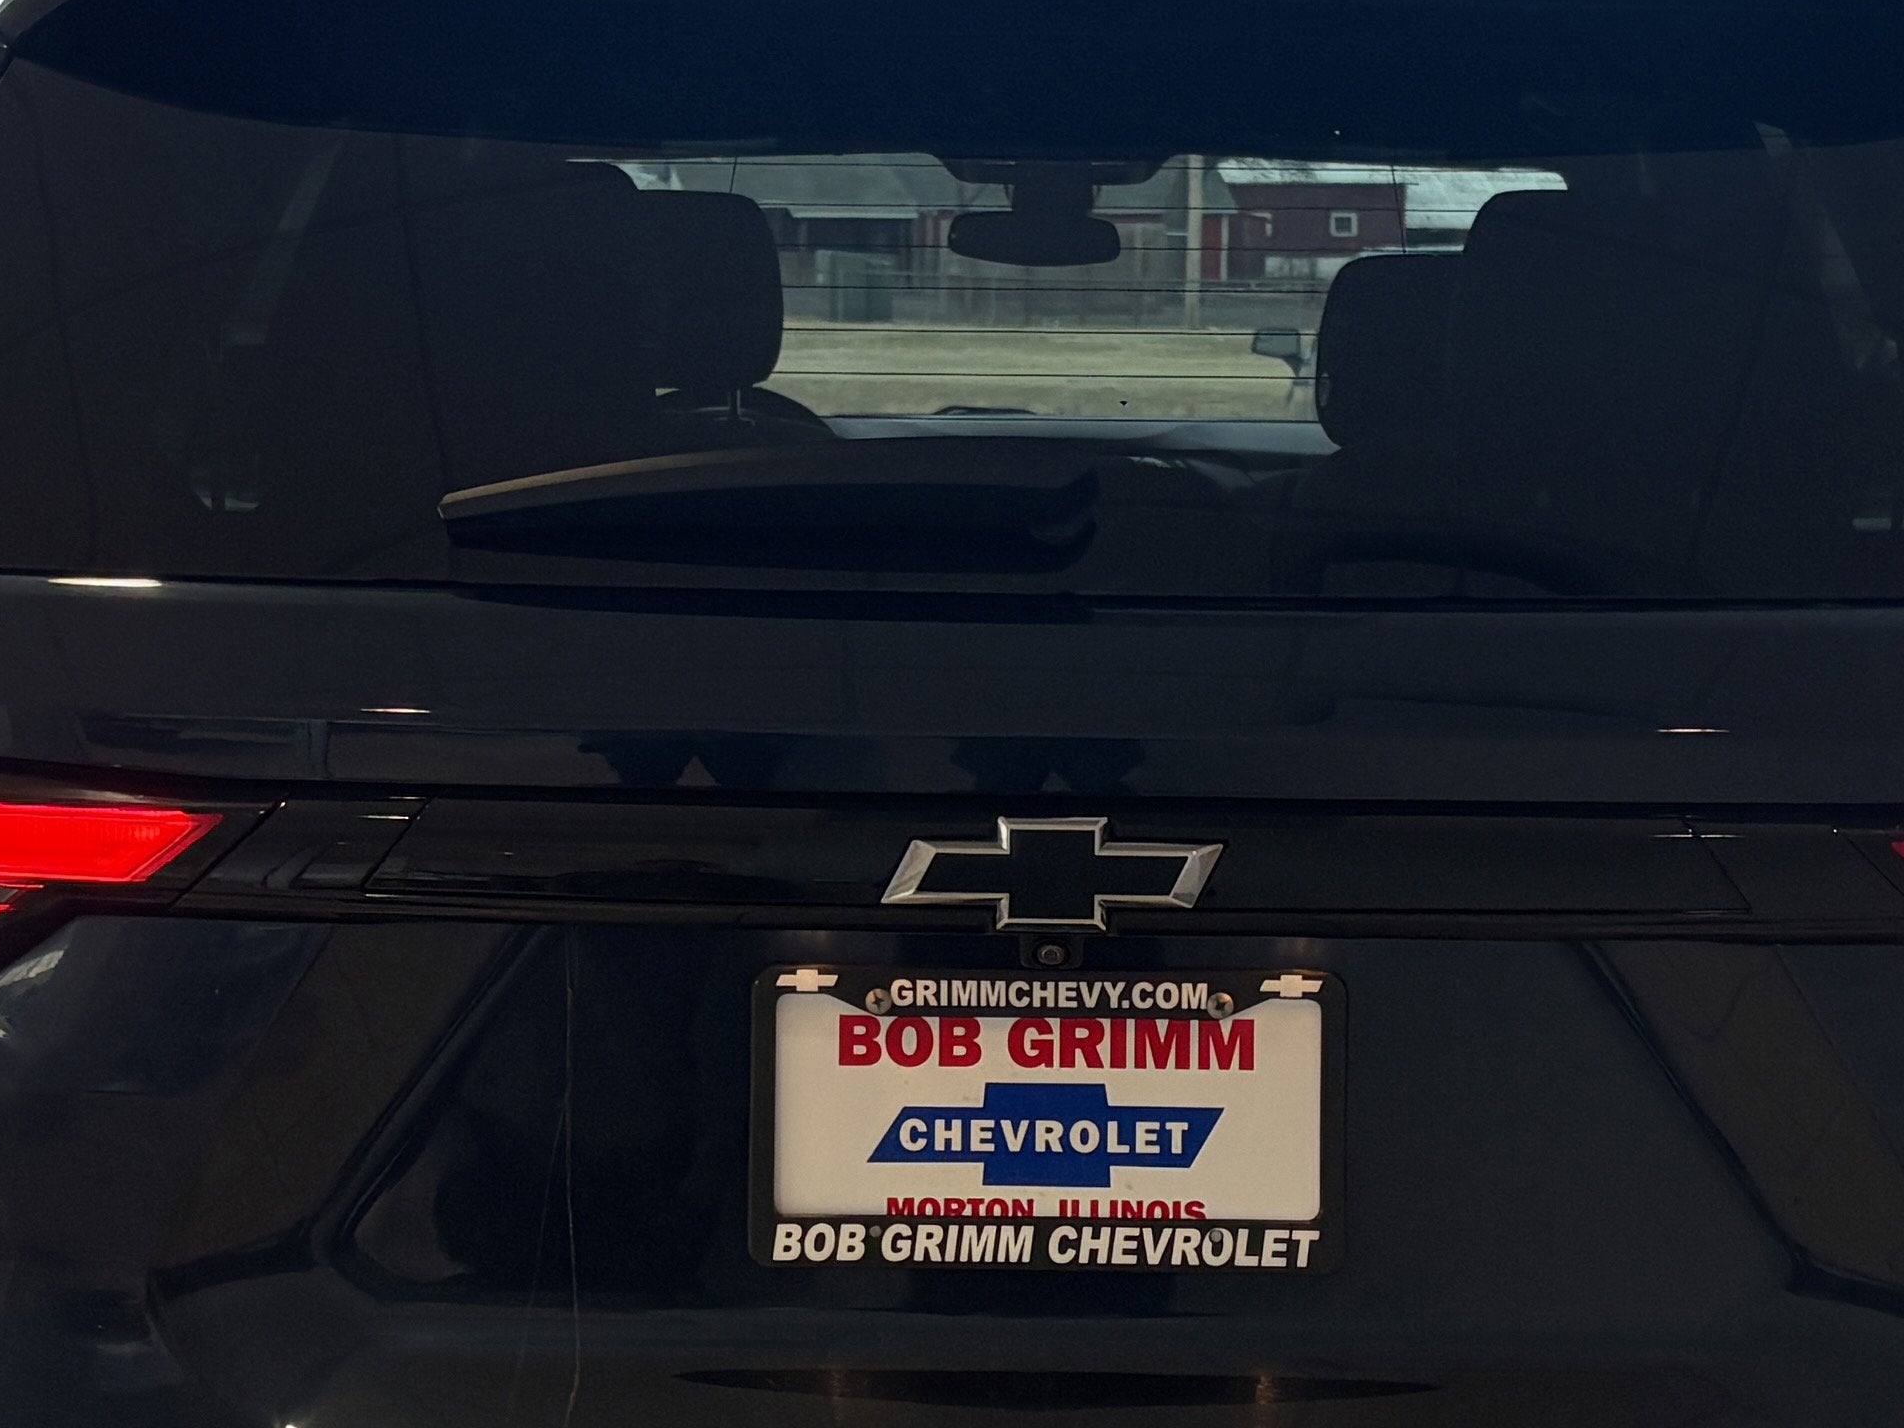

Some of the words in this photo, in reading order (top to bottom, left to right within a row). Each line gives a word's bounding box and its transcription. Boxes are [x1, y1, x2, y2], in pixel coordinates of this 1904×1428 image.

[889, 978, 1209, 1010] GRIMMCHEVY.COM
[838, 1013, 983, 1068] BOB
[1007, 1016, 1255, 1071] GRIMM
[898, 1117, 1189, 1155] CHEVROLET
[885, 1196, 1035, 1219] MORTON
[1058, 1198, 1208, 1220] ILLINOIS
[771, 1222, 867, 1263] BOB
[880, 1223, 1035, 1264] GRIMM
[1047, 1224, 1321, 1269] CHEVROLET
